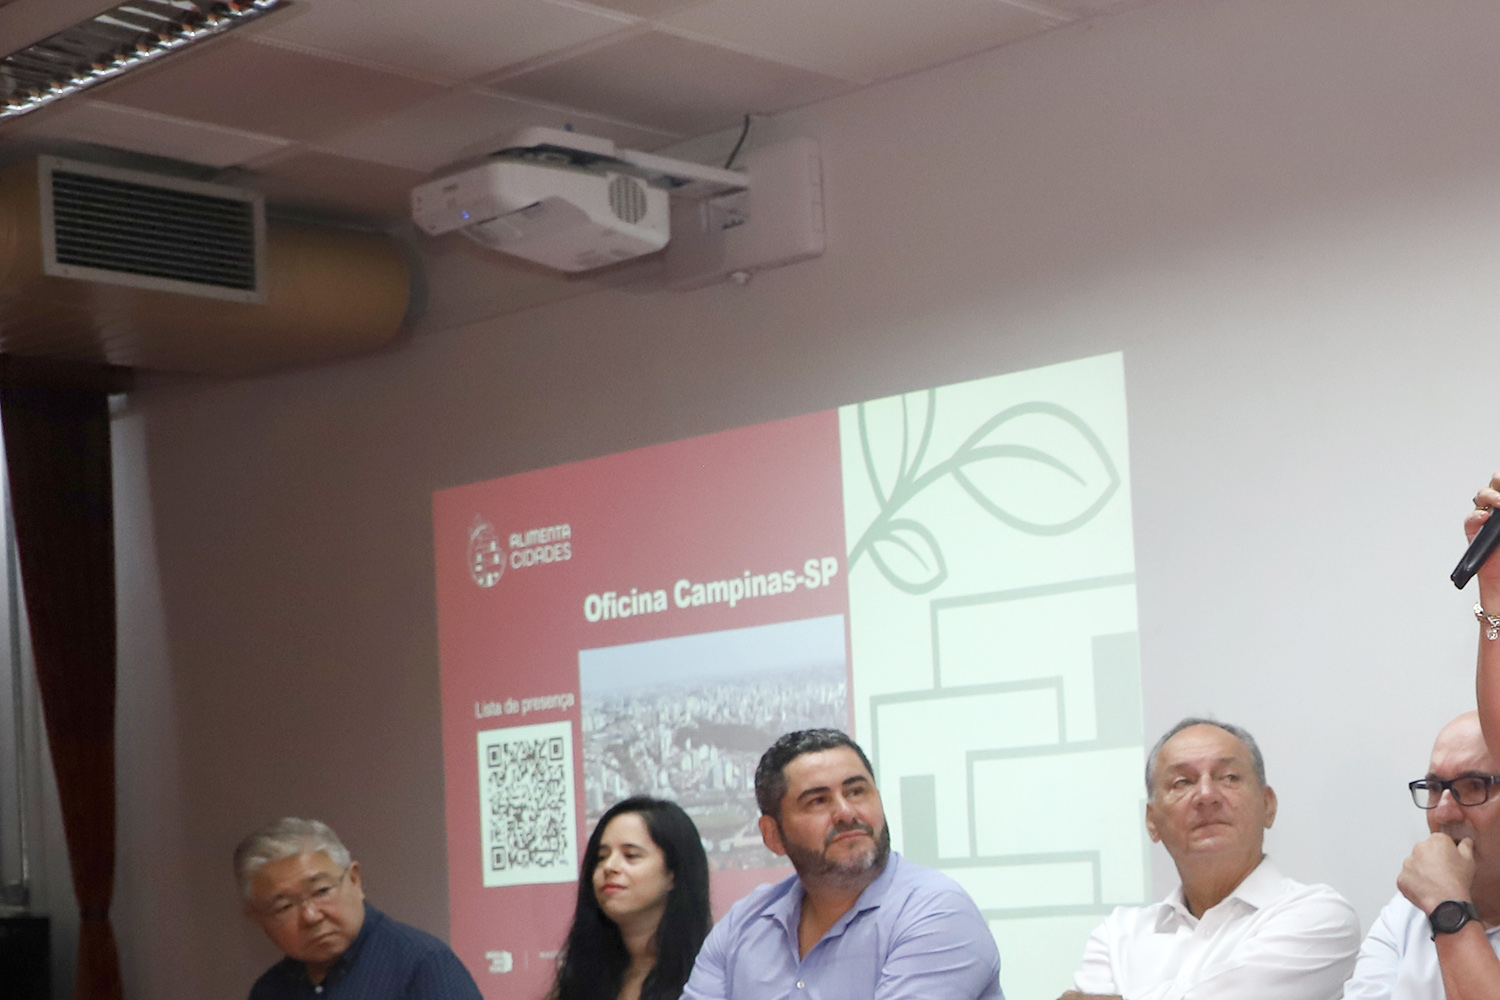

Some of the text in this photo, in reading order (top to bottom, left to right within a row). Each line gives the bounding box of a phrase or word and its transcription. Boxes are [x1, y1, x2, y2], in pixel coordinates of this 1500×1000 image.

[510, 542, 571, 569] CIDADES
[584, 556, 838, 623] Oficina Campinas-SP
[475, 693, 575, 719] Lista de presença
